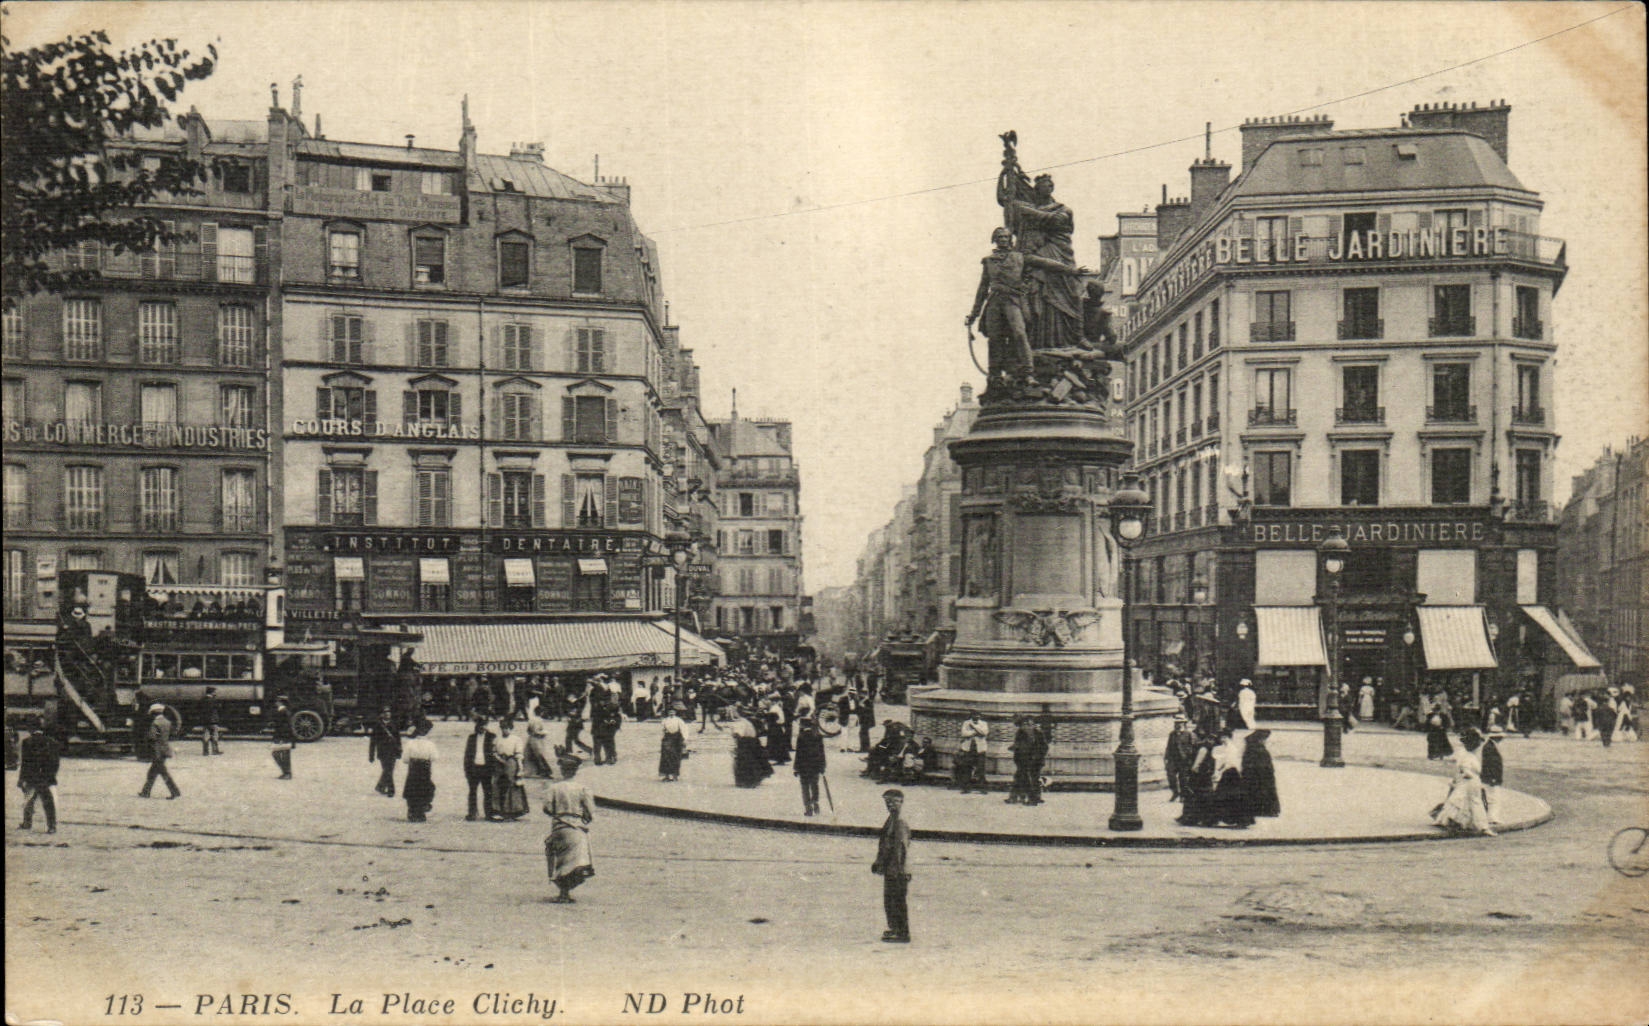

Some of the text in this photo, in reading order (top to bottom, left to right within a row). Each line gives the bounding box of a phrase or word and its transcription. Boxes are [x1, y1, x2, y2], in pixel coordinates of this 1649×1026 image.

[1215, 231, 1309, 264] BELLE
[44, 421, 142, 446] COMMERCE
[165, 424, 266, 449] INDUSTRIES
[293, 418, 362, 435] COURS
[1254, 522, 1484, 542] BELLE JARDINIERE
[334, 536, 451, 550] INSTITUT
[503, 537, 614, 552] DENTAIRE
[290, 609, 340, 620] VILLETTE
